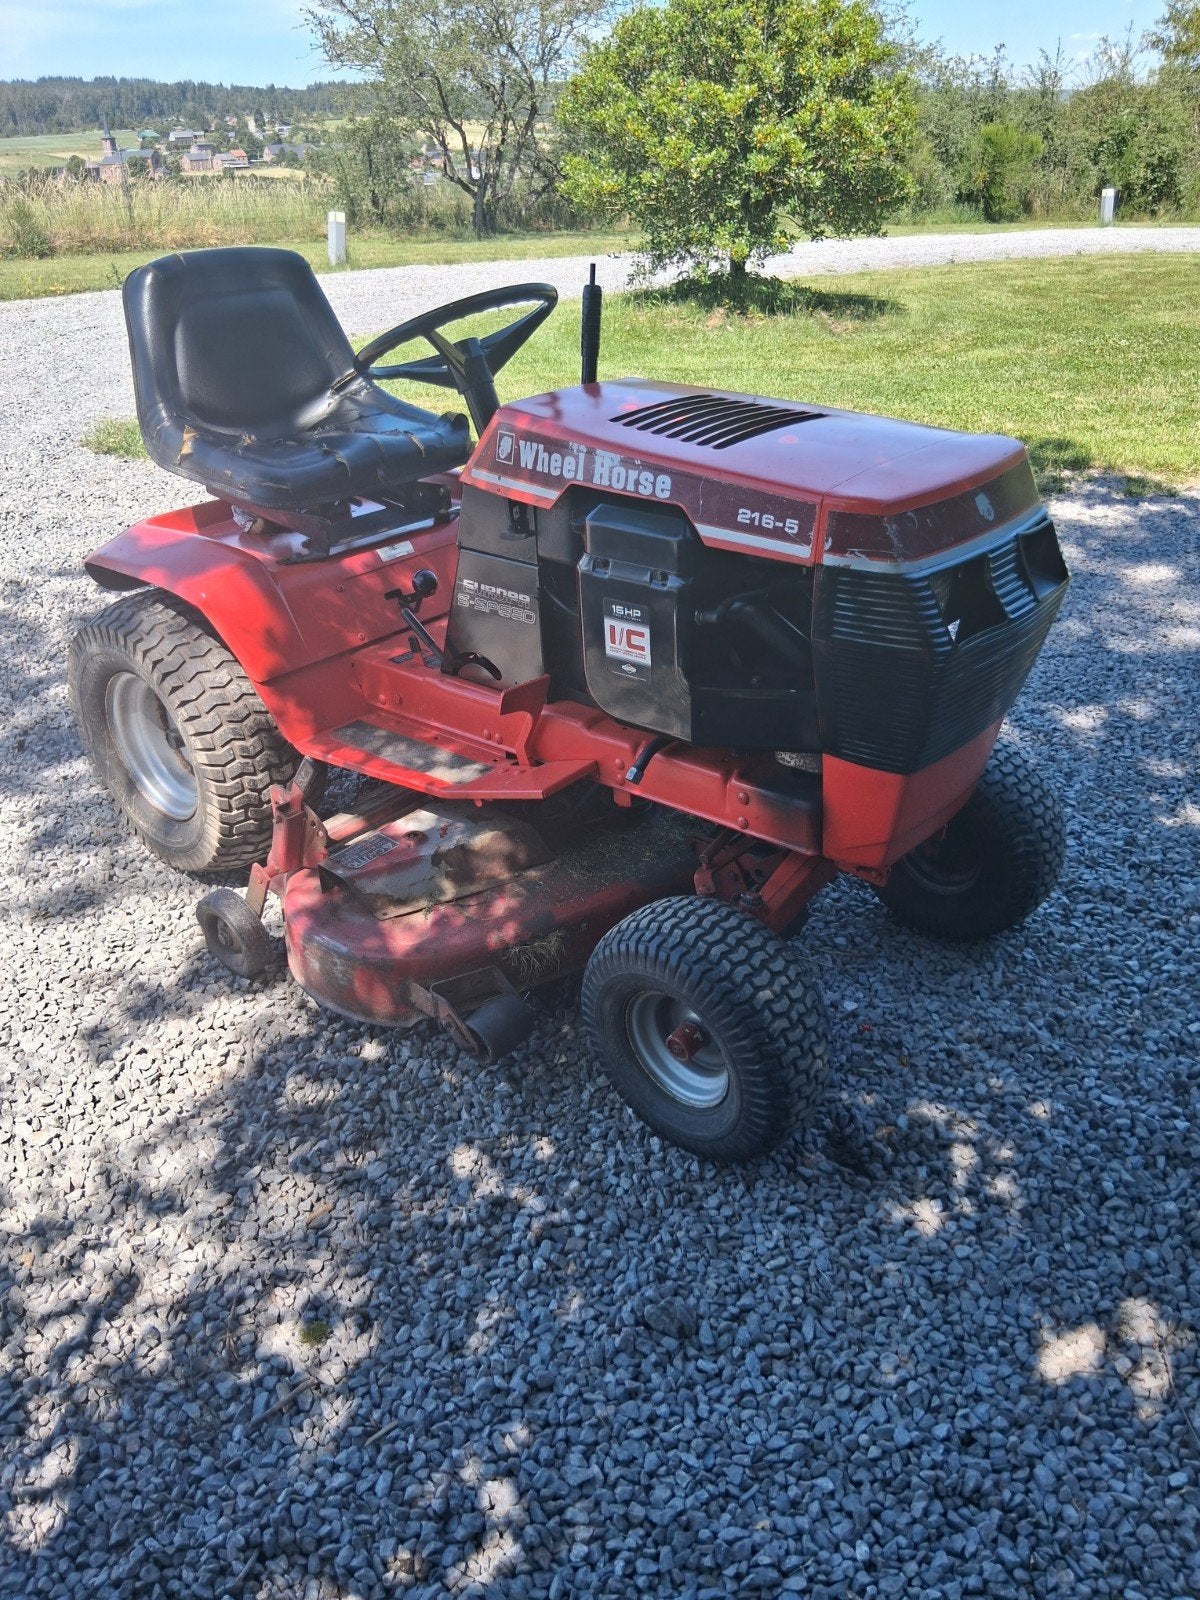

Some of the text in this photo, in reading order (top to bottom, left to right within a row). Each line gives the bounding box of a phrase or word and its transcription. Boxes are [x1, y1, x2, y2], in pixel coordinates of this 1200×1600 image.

[518, 440, 672, 499] Wheel Horse
[736, 508, 799, 535] 216-5
[609, 624, 646, 653] I/C
